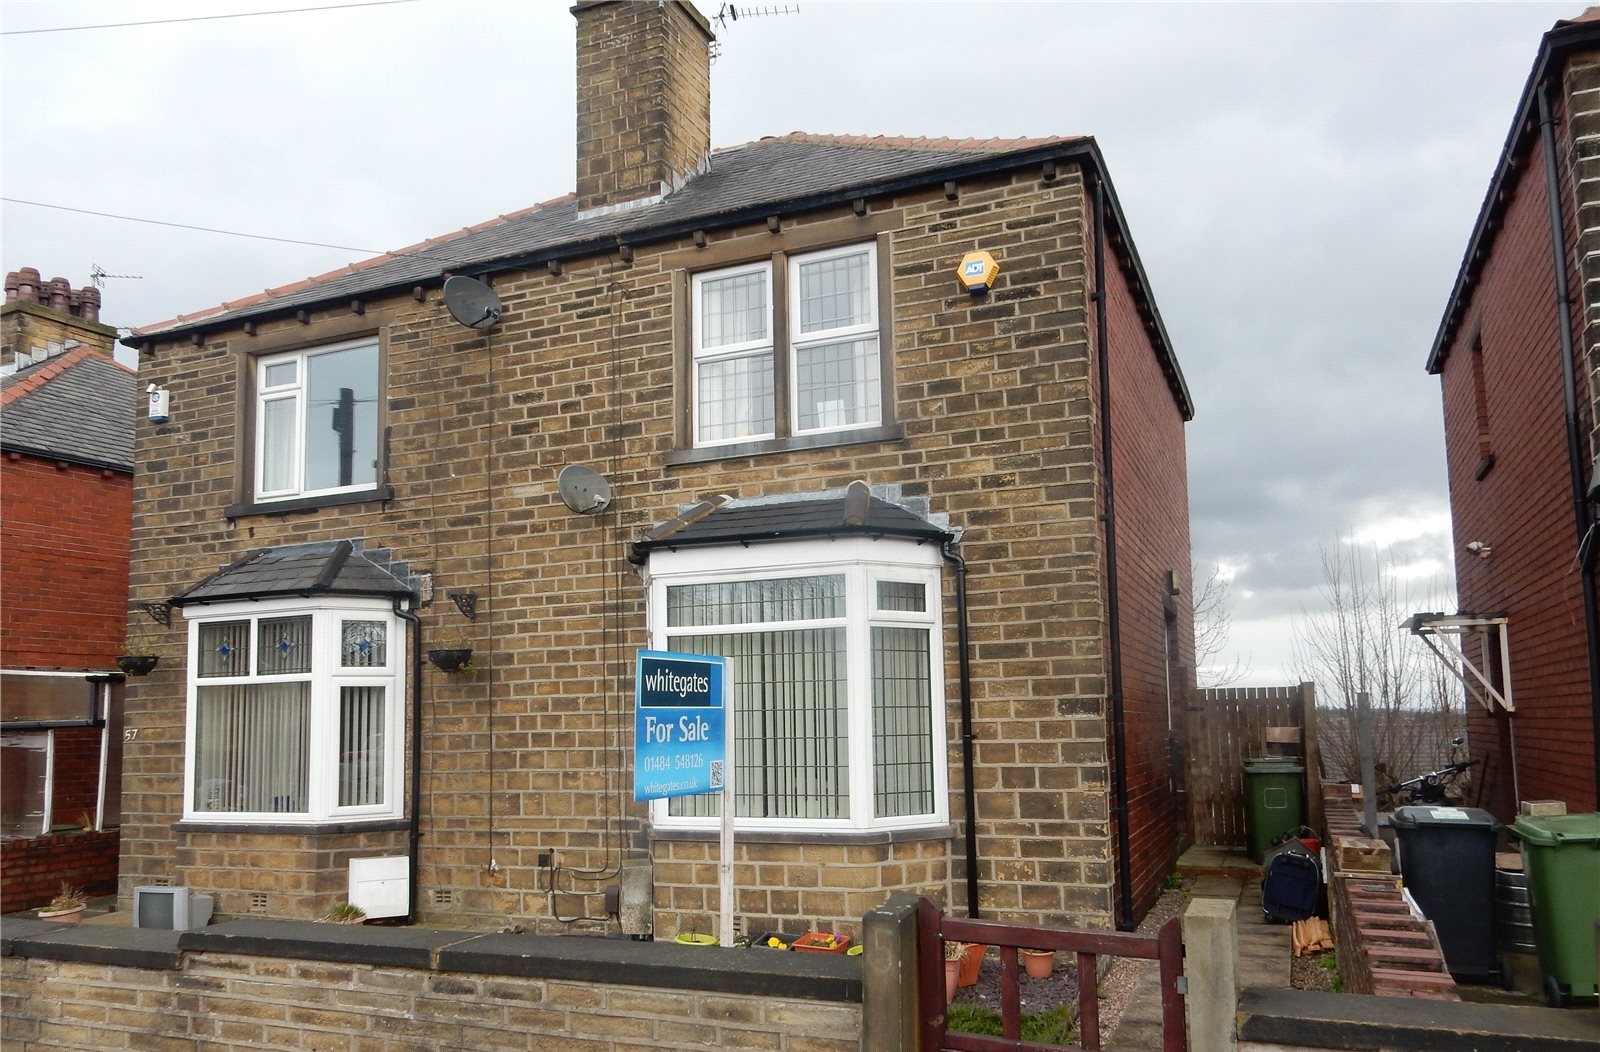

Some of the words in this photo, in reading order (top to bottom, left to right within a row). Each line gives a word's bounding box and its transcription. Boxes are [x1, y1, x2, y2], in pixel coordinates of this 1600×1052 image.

[965, 261, 985, 275] ADT
[645, 668, 709, 698] whitegates
[125, 728, 138, 741] 57
[645, 716, 674, 743] For
[679, 715, 709, 742] Sale
[644, 755, 671, 772] 01484
[675, 753, 704, 770] 548126
[644, 777, 698, 796] whitegates.co.uk
